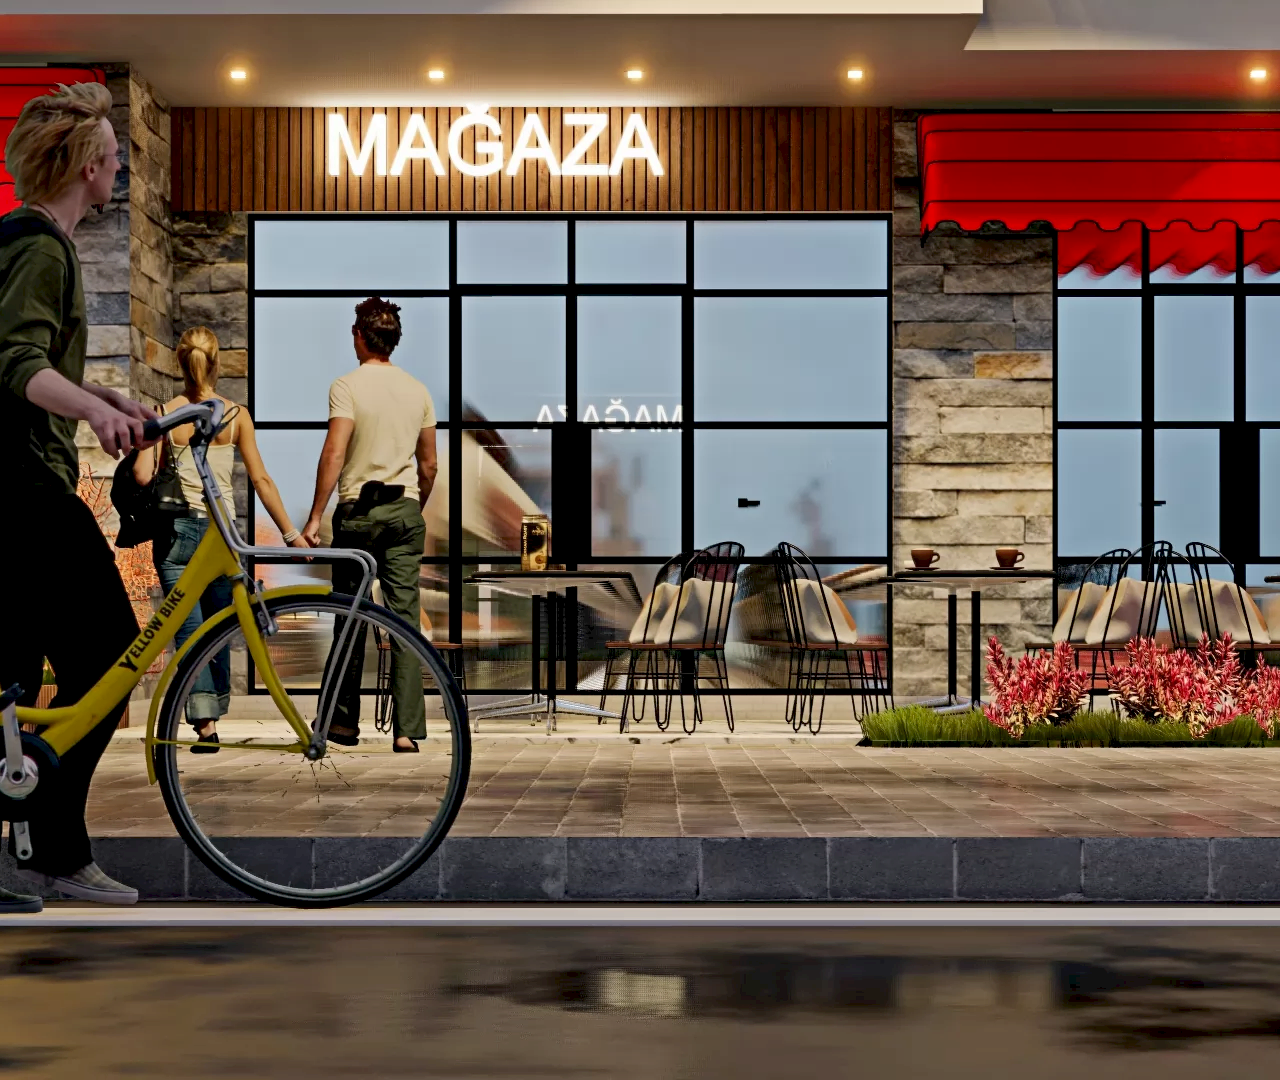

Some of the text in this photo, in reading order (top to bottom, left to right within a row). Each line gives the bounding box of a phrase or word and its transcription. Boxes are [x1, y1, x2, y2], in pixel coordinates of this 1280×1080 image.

[328, 103, 665, 176] MAĞAZA
[118, 587, 186, 673] YELLOW BIKE
